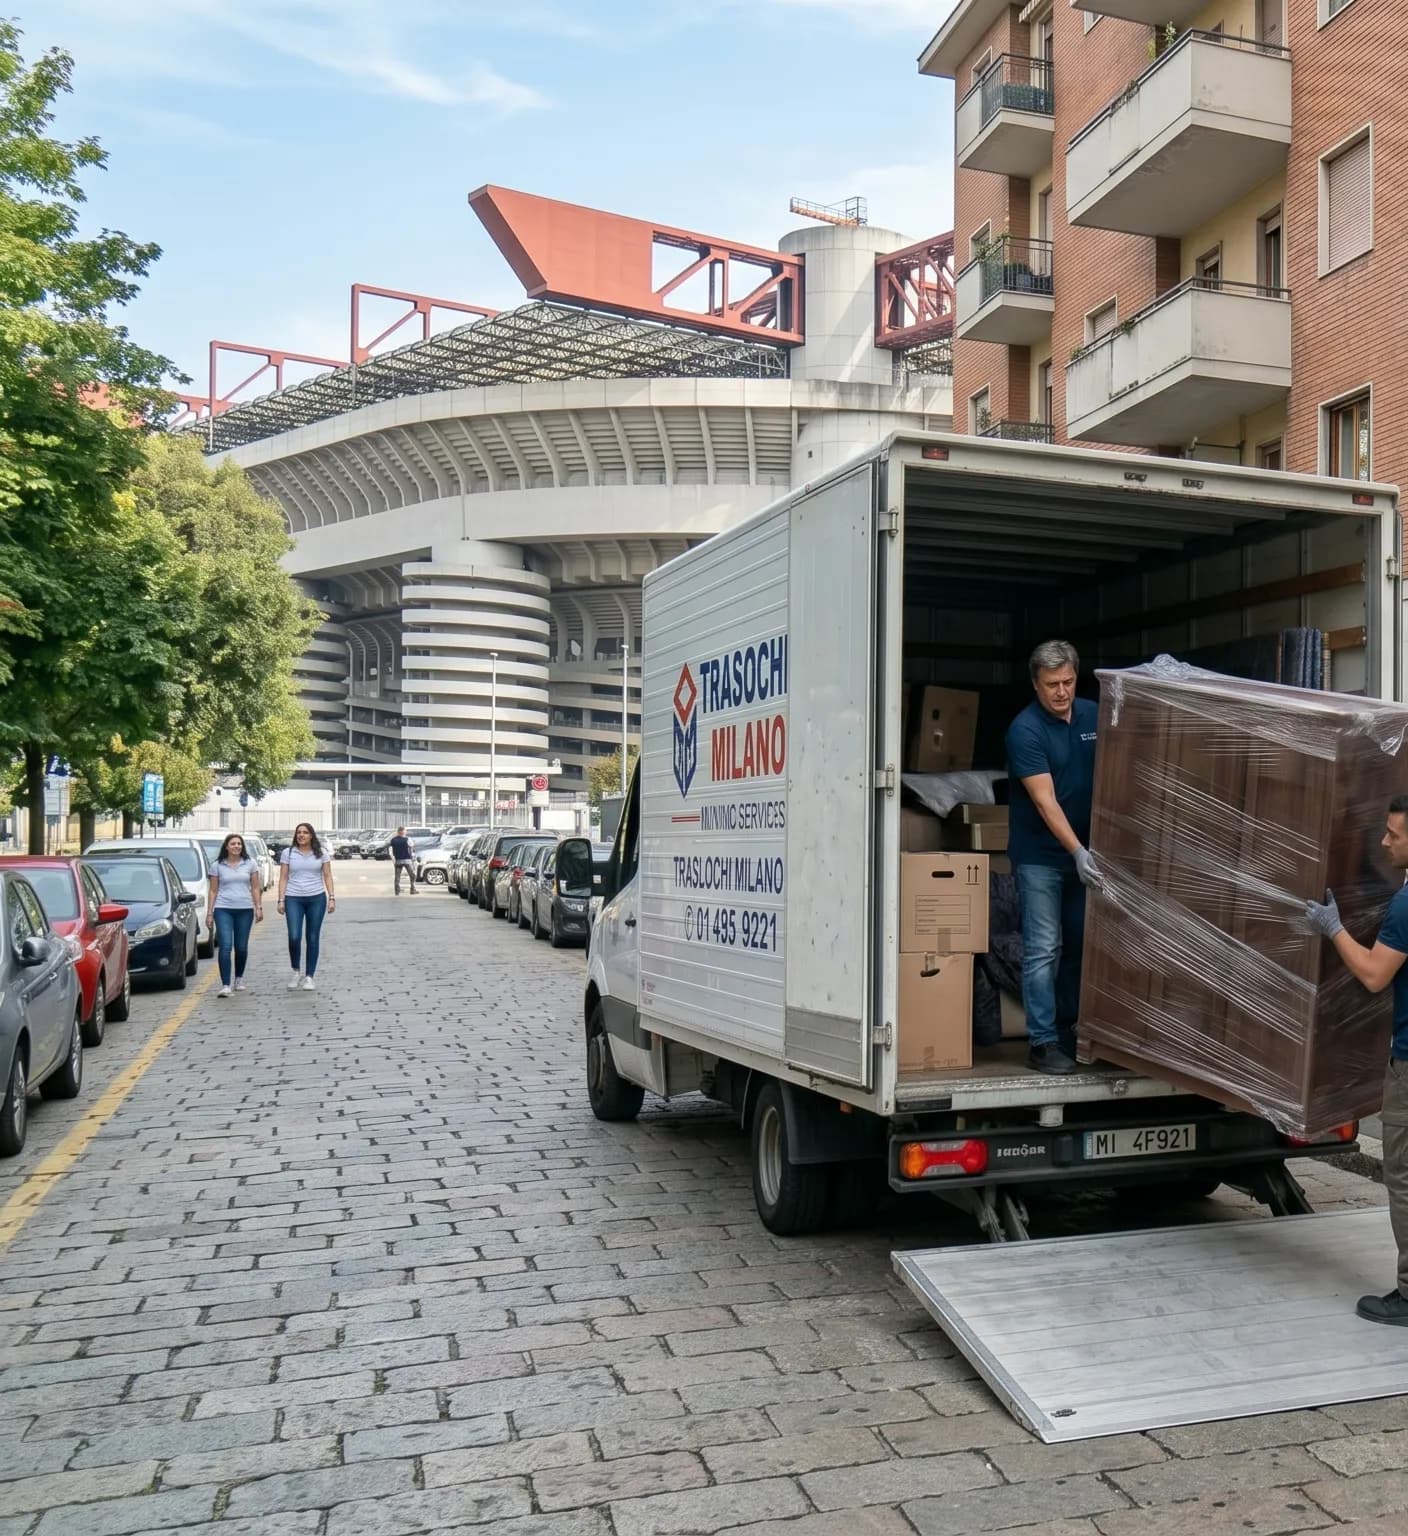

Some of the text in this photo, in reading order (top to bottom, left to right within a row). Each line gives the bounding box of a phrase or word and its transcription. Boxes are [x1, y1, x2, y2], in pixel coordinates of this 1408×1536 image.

[700, 634, 788, 714] TRASOCHI
[711, 714, 786, 782] MILANO
[738, 800, 786, 830] SERVICES
[674, 856, 784, 894] TRASLOCHI MILANO
[742, 910, 777, 952] 9221
[1096, 1127, 1189, 1155] MI 4F921
